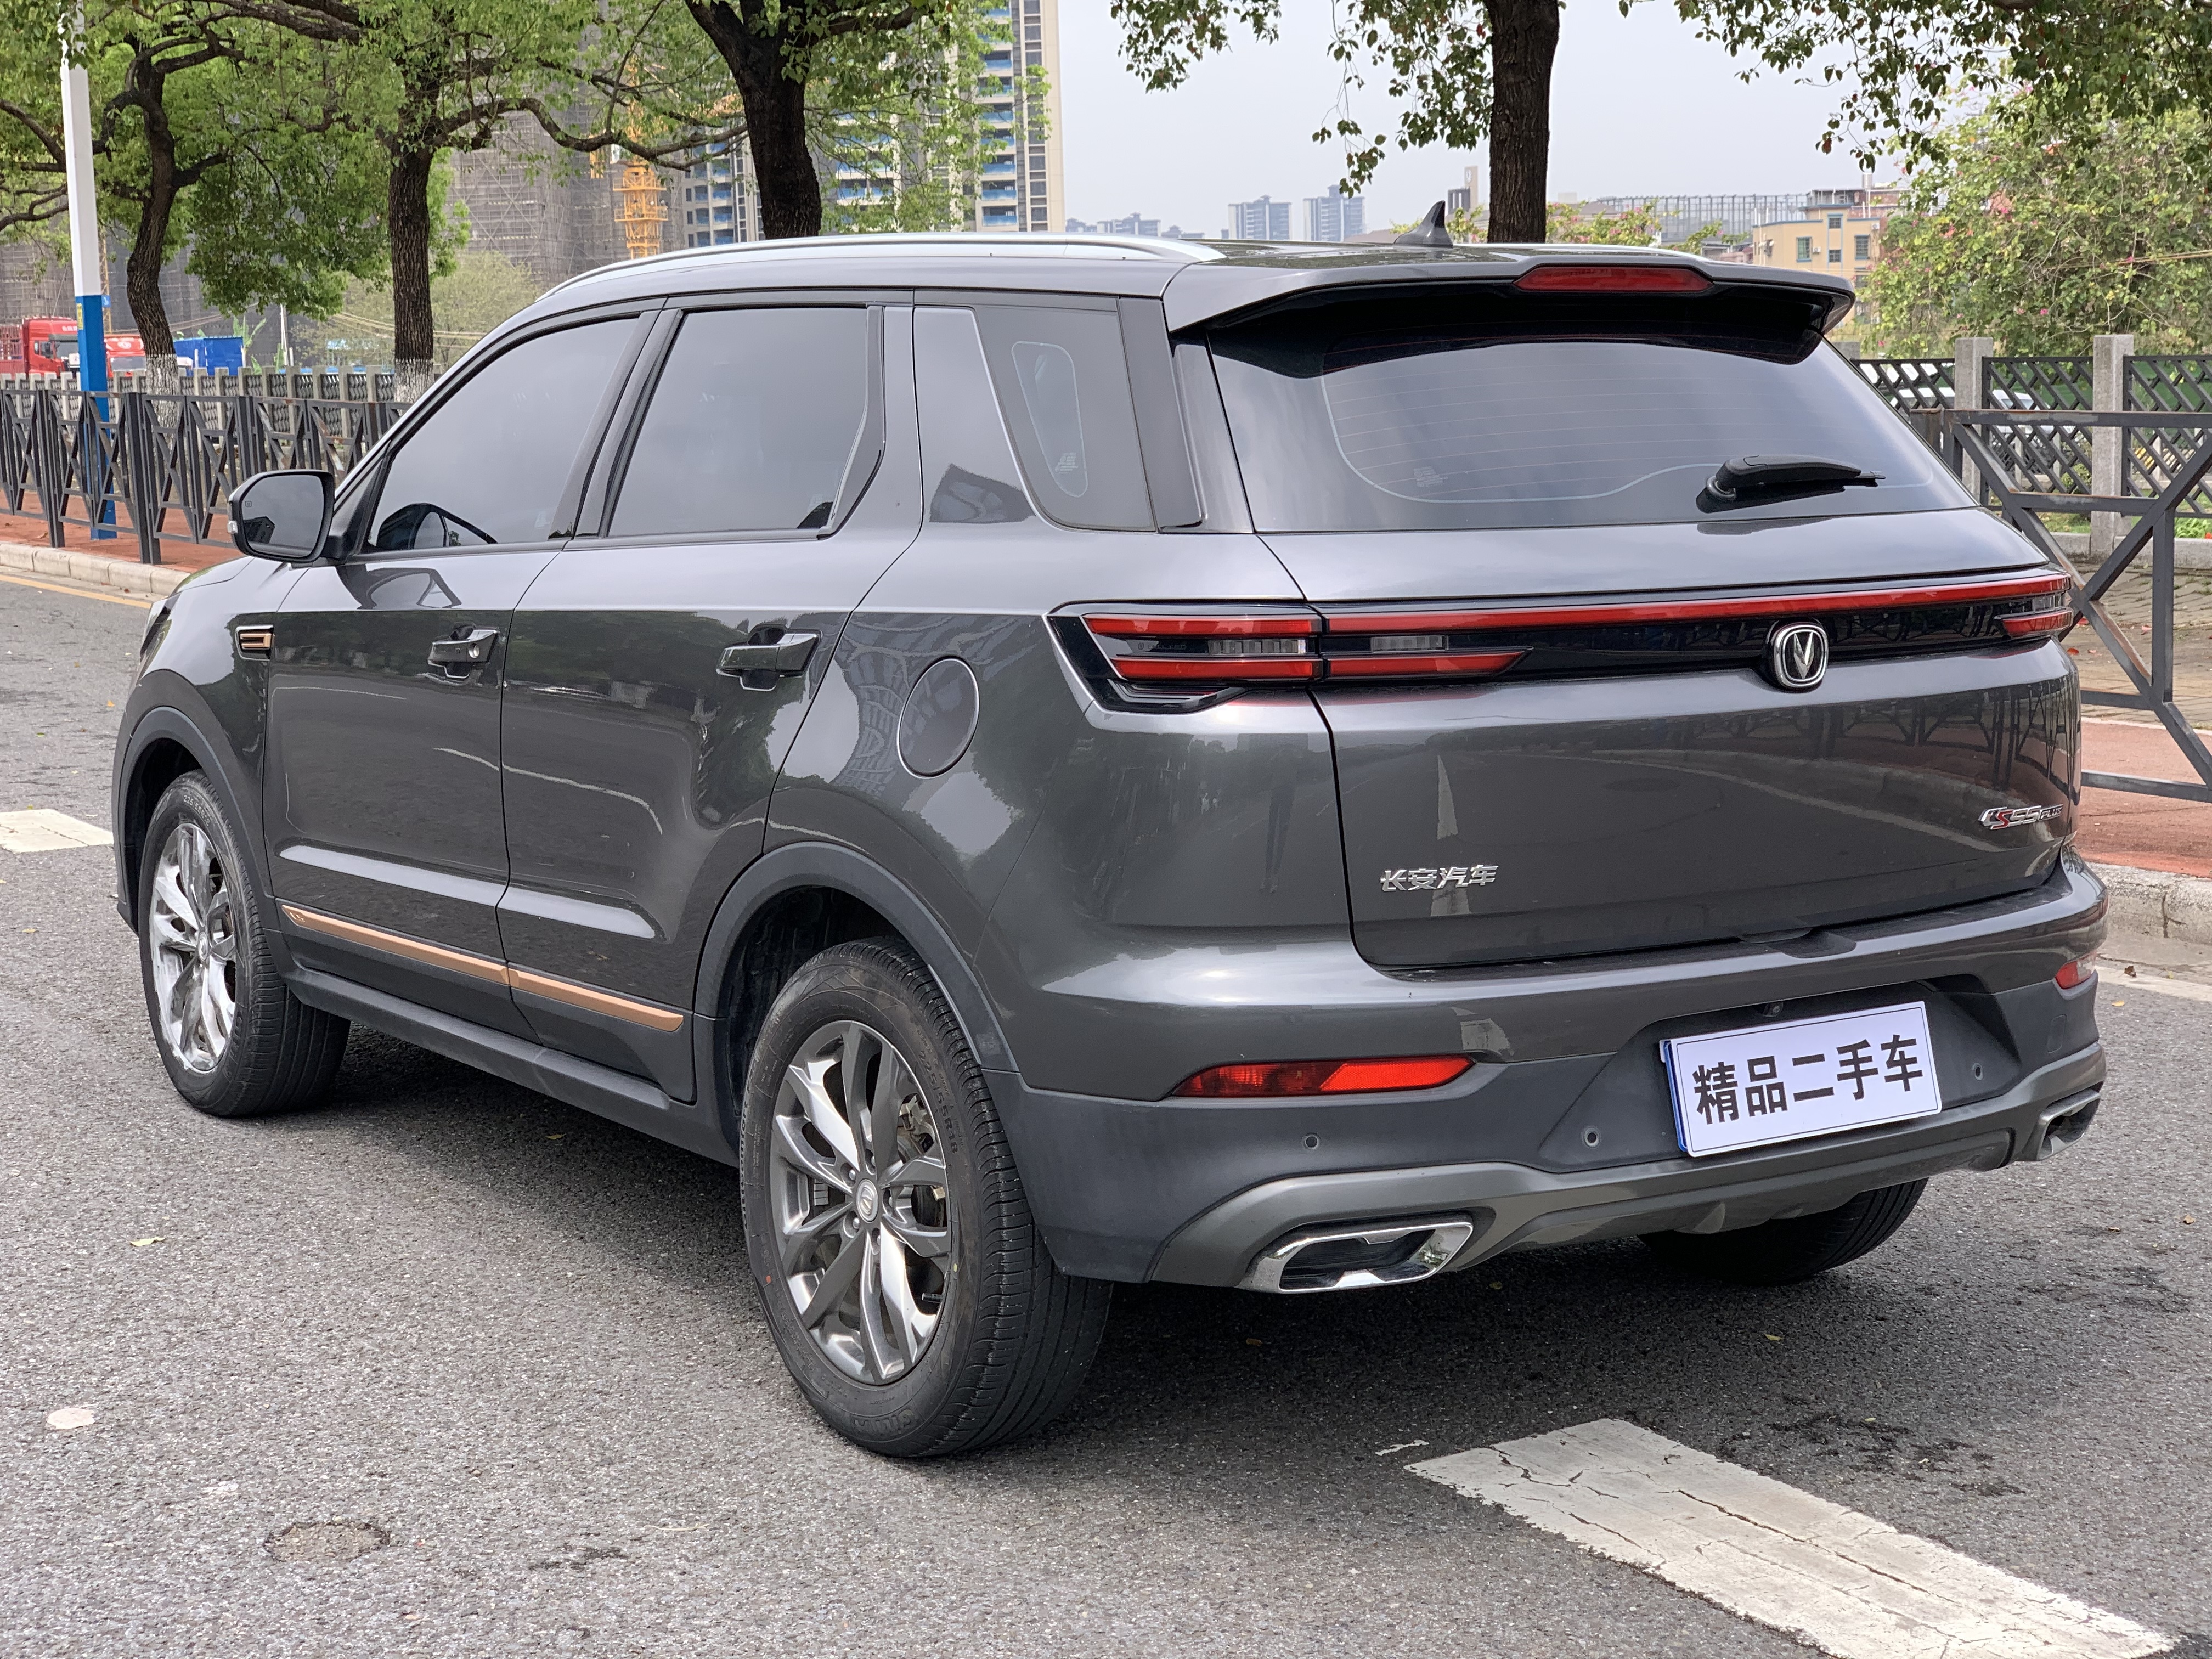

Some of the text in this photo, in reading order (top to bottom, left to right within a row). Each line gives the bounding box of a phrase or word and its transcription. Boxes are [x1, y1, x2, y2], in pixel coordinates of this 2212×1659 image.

[1978, 805, 2063, 830] CS55 PLUS
[1379, 865, 1499, 892] 长安汽车
[919, 1050, 958, 1154] 225/55R18
[1691, 1034, 1923, 1125] 精品二手车
